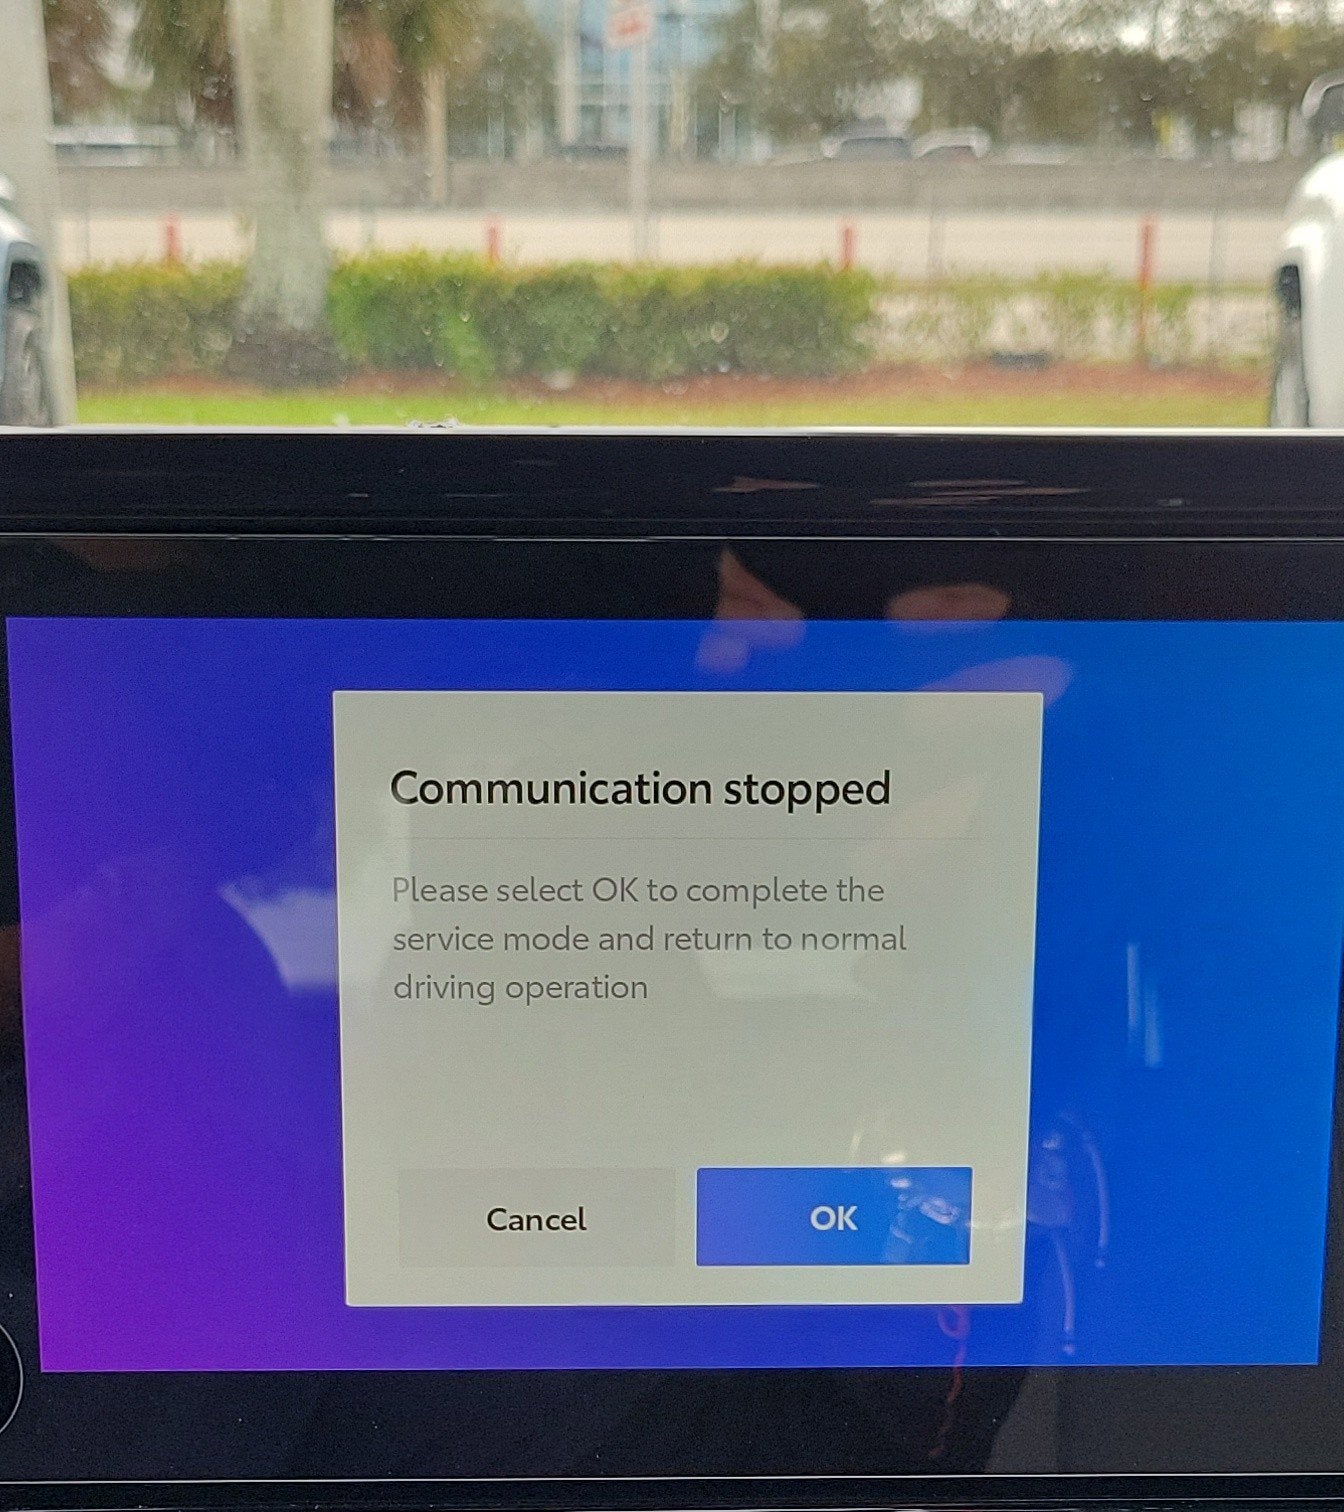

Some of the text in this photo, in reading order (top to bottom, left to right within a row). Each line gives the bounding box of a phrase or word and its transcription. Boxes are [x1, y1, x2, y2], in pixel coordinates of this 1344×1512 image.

[390, 770, 892, 815] Communication stopped
[391, 876, 885, 908] Please select OK to complete the
[392, 924, 907, 952] service mode and return to normal
[393, 974, 648, 1005] driving operation
[486, 1206, 587, 1232] Cancel
[810, 1206, 858, 1231] OK
